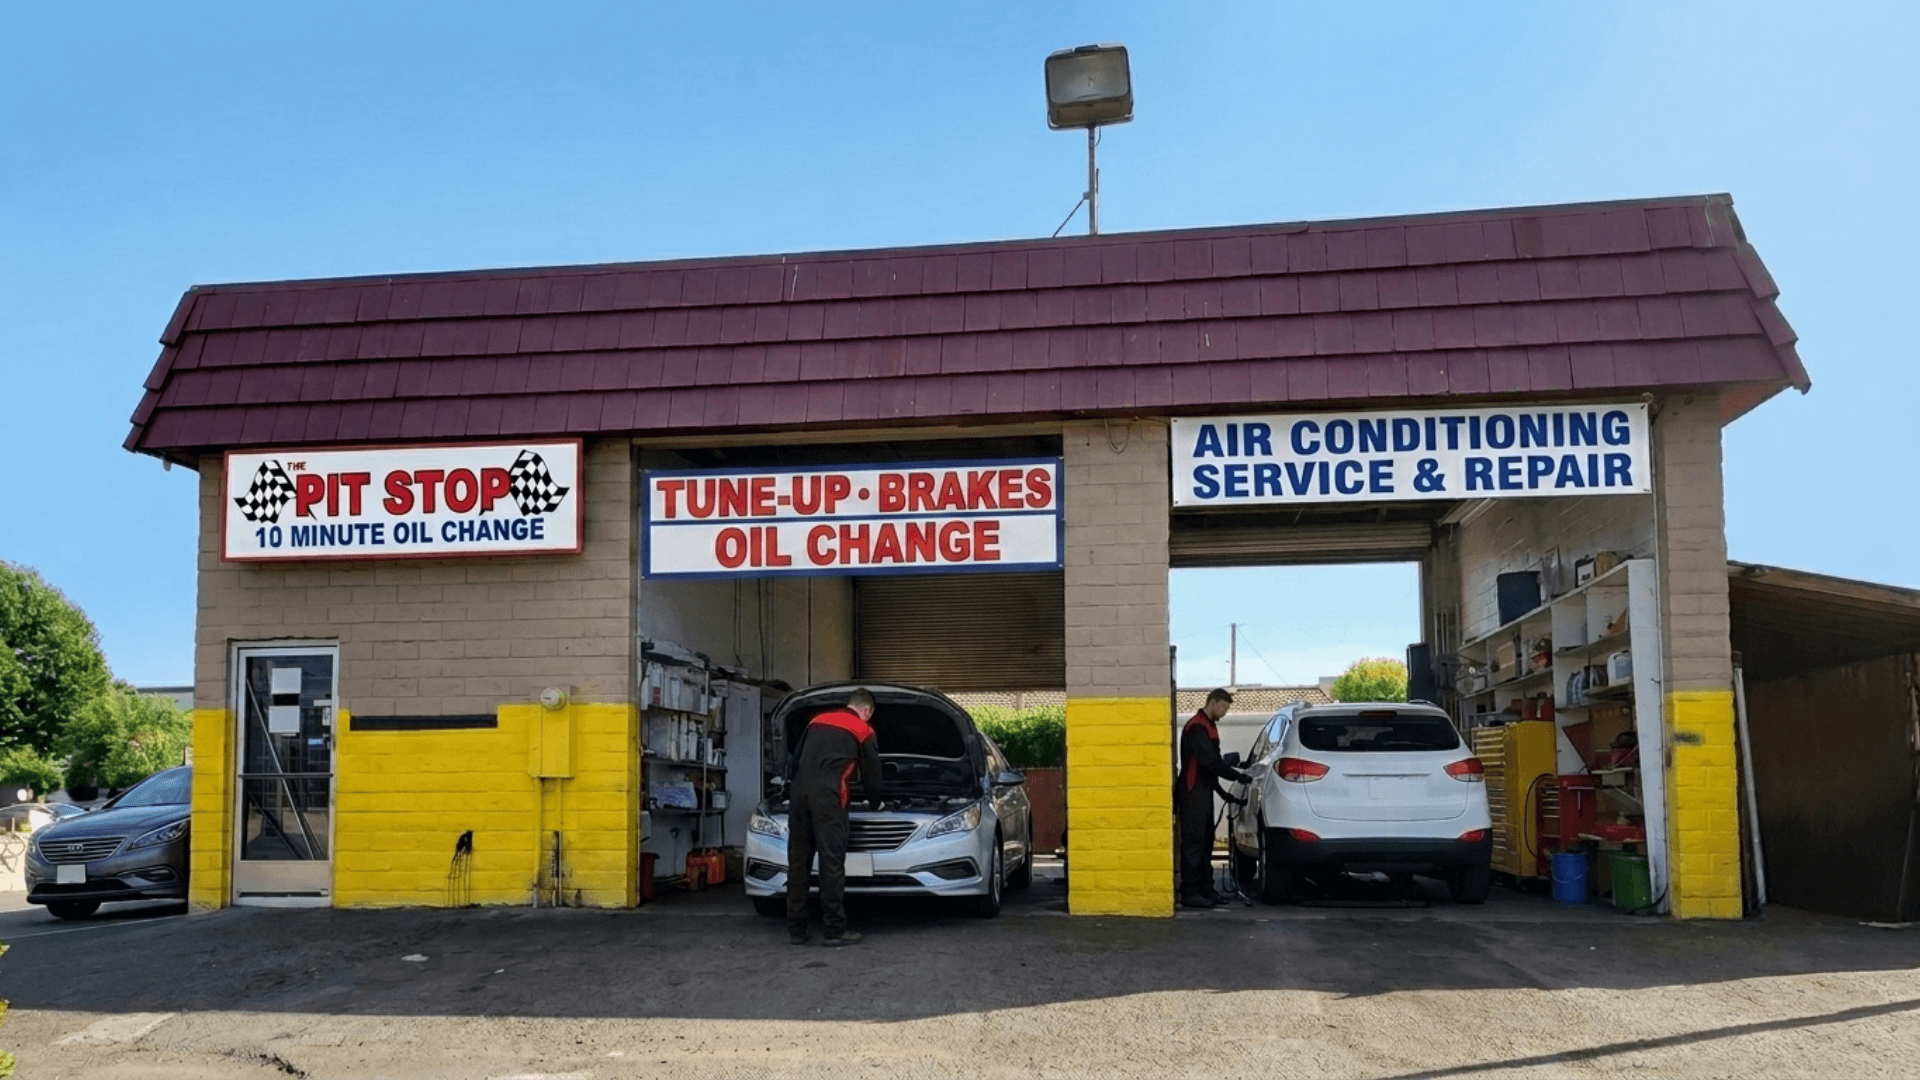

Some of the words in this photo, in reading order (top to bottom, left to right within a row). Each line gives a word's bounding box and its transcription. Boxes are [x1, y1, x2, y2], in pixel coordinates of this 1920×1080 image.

[1192, 422, 1273, 458] AIR
[1290, 410, 1631, 457] CONDITIONING
[287, 461, 307, 471] THE
[1192, 458, 1395, 500] SERVICE
[1413, 458, 1446, 493] &
[1464, 452, 1634, 492] REPAIR
[295, 471, 371, 518] PIT
[383, 467, 512, 516] STOP
[656, 474, 851, 519] TUNE-UP
[878, 468, 1052, 513] BRAKES
[255, 525, 282, 548] 10
[290, 522, 385, 547] MINUTE
[393, 521, 433, 544] OIL
[440, 517, 545, 543] CHANGE
[714, 526, 792, 568] OIL
[806, 520, 1001, 566] CHANGE
